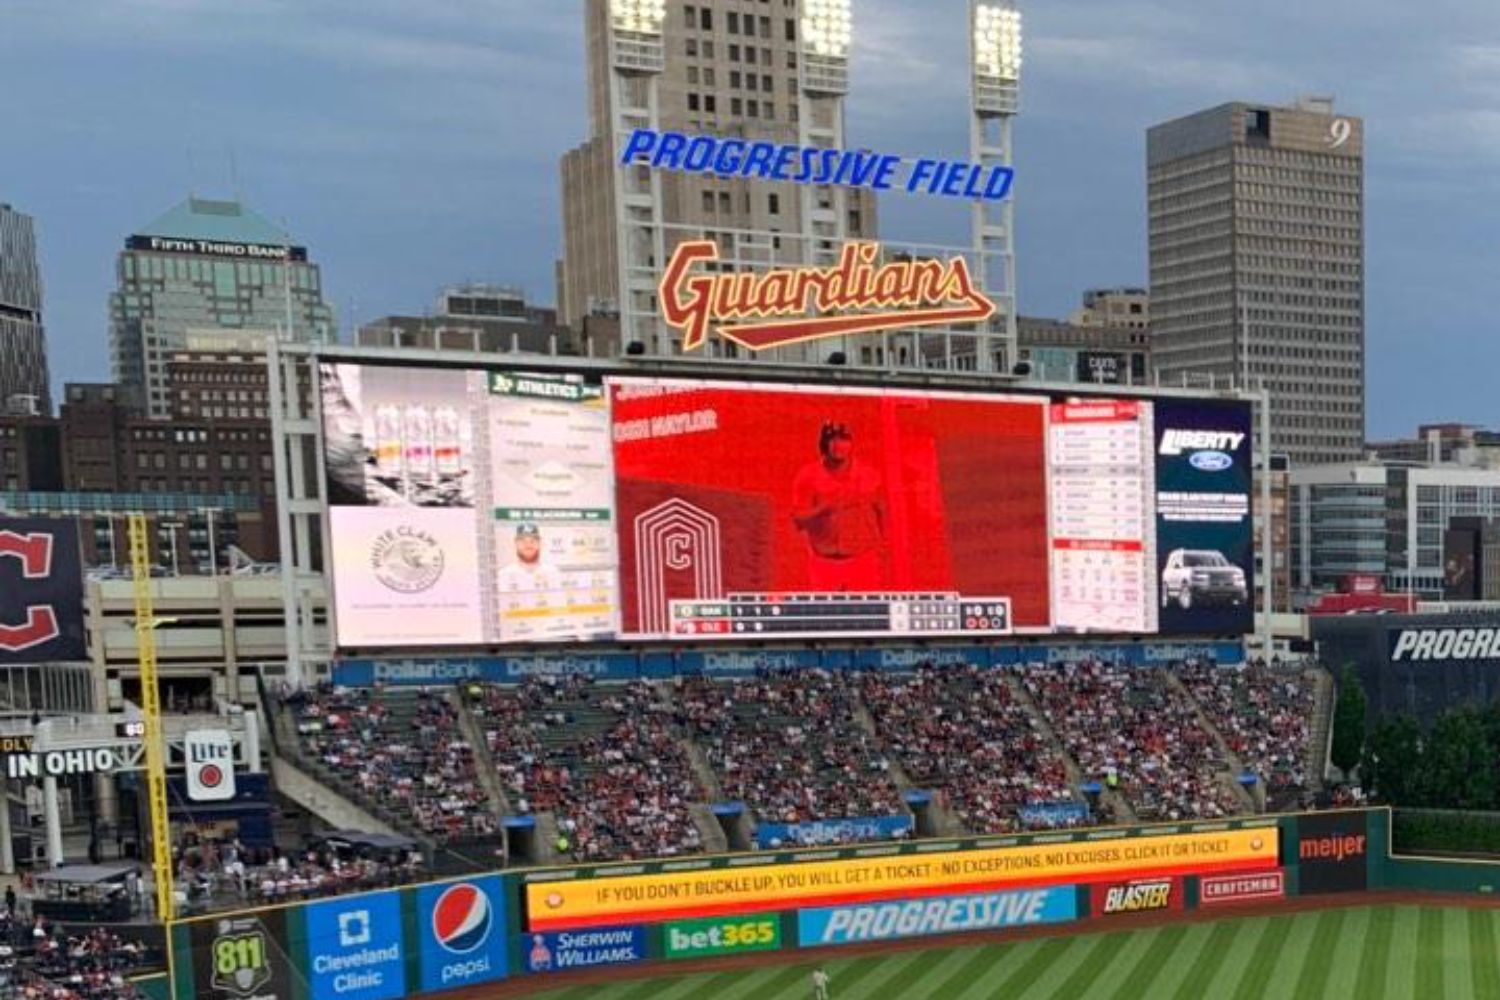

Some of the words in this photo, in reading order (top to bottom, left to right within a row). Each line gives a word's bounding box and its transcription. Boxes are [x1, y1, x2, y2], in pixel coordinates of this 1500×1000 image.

[1325, 117, 1351, 149] 9
[621, 128, 901, 190] PROGRESSIVE
[907, 158, 1014, 200] FIELD
[151, 237, 194, 251] FIFTH
[195, 240, 245, 256] THIRD
[658, 240, 997, 352] Guardians
[1158, 428, 1245, 455] LIBERTY
[372, 660, 482, 680] DollarBank
[506, 657, 609, 677] DollarBank
[8, 753, 39, 779] IN
[45, 749, 114, 775] OHIO
[1300, 834, 1366, 862] meijer
[612, 884, 645, 902] YOU
[647, 880, 692, 900] DON'T
[694, 878, 752, 898] BUCKLE
[777, 874, 806, 891] YOU
[808, 871, 843, 887] WILL
[845, 868, 872, 885] GET
[872, 866, 883, 881] A
[886, 860, 932, 879] TICKET
[940, 858, 961, 875] NO
[1044, 849, 1065, 867] NO
[1123, 843, 1158, 861] CLICK
[1191, 838, 1231, 857] TICKET
[1104, 880, 1171, 915] BLASTER
[821, 889, 1050, 943] PROGRESSIVE
[556, 930, 634, 951] SHERWIN
[670, 921, 776, 951] bet365
[216, 936, 262, 975] 811
[313, 943, 400, 974] Cleveland
[441, 954, 491, 983] pepsi
[333, 970, 384, 993] Clinic
